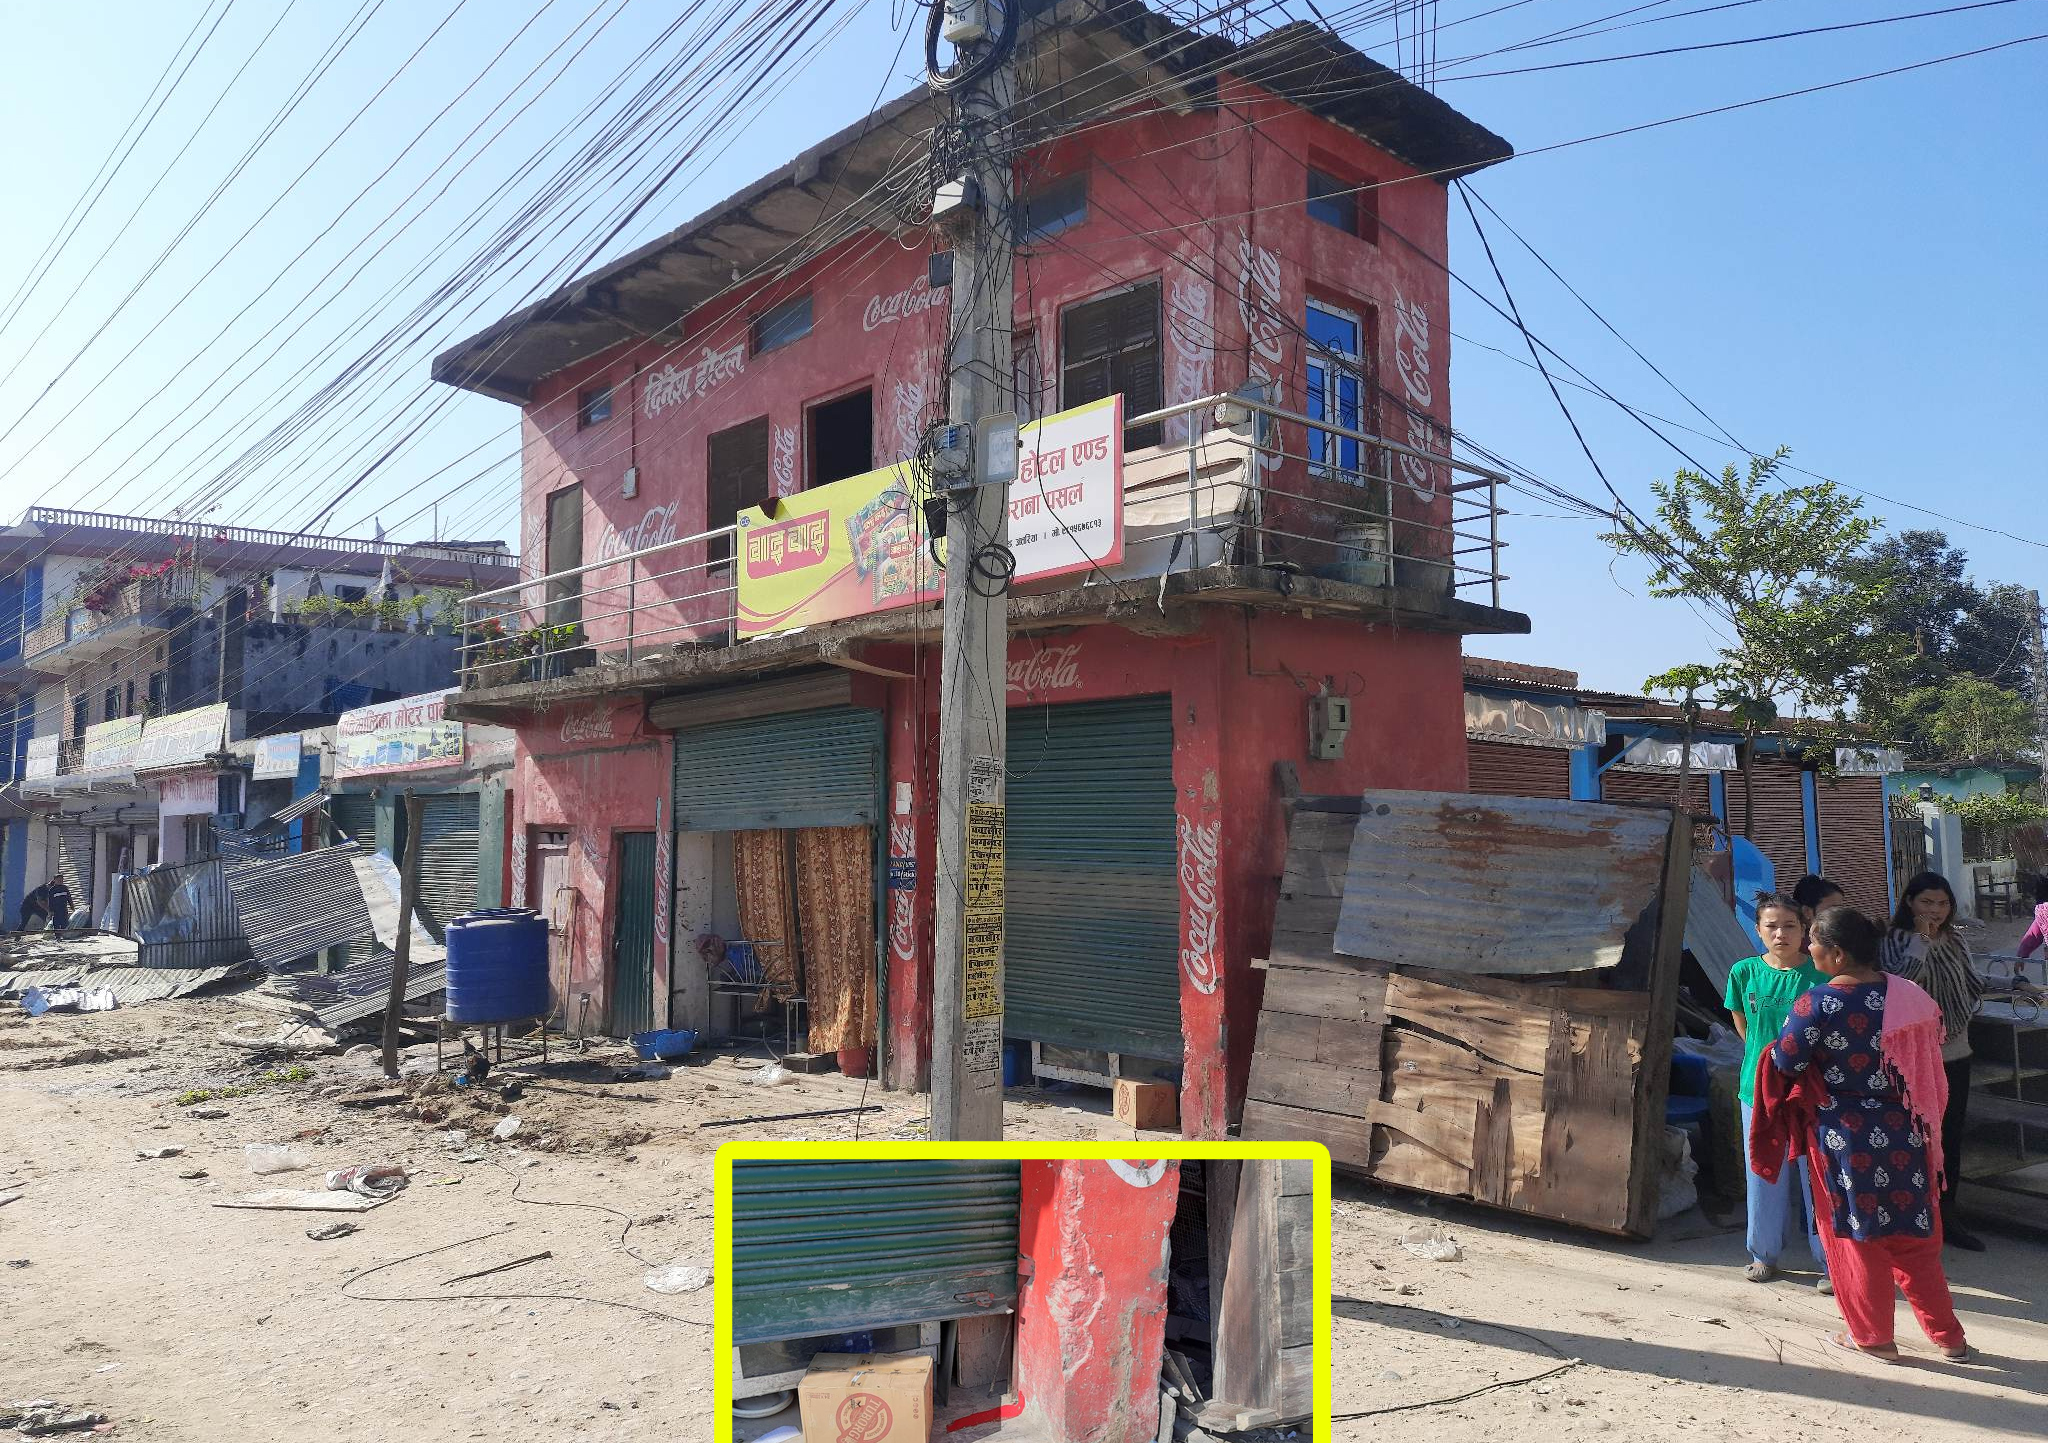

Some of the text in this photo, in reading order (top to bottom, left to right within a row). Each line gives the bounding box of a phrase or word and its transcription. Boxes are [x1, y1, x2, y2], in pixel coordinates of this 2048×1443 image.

[1020, 447, 1067, 484] होटल
[1072, 434, 1110, 467] एण्ड
[1008, 482, 1084, 521] राना पसल
[847, 1398, 883, 1440] TUBORG
